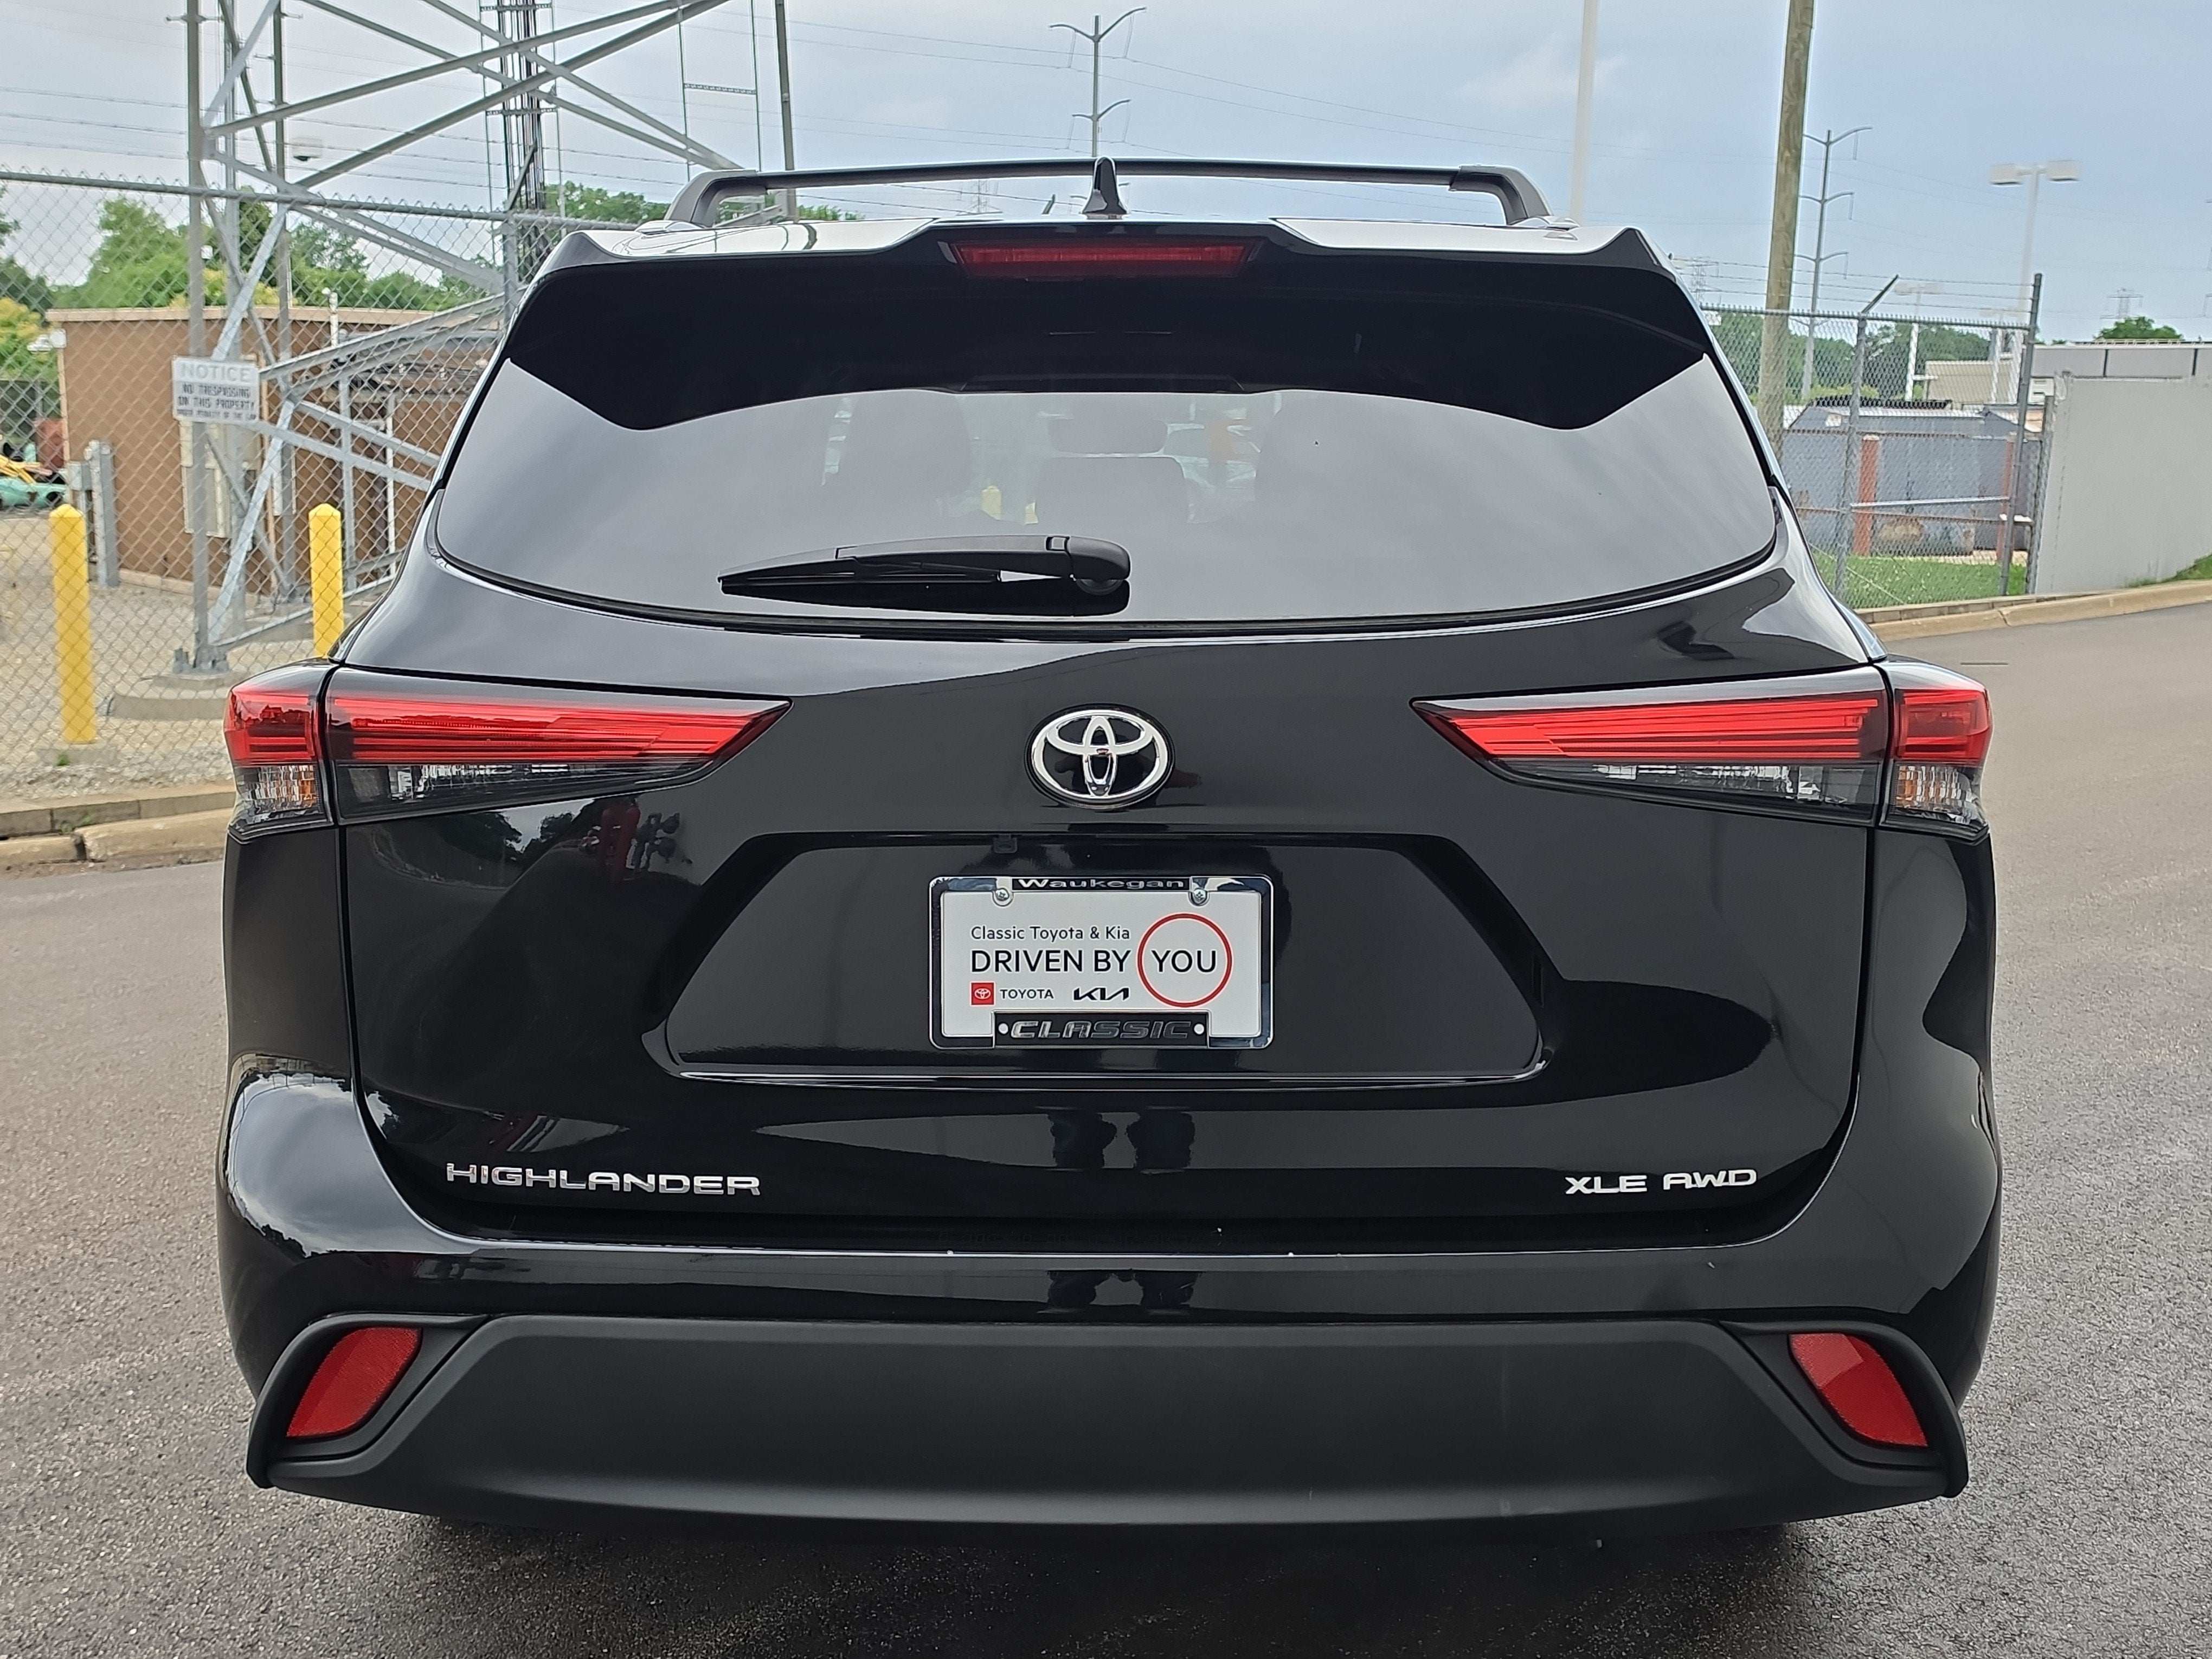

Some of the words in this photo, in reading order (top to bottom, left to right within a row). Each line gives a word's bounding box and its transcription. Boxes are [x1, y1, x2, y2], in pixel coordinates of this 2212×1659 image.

[181, 363, 250, 382] NOTICE
[182, 383, 194, 395] NO
[198, 385, 250, 398] TRESPASSING
[178, 396, 189, 406] ON
[193, 397, 211, 408] THIS
[215, 399, 255, 411] PROPERTY
[1018, 879, 1184, 890] Waukegan
[971, 926, 1025, 940] Classic
[1029, 926, 1084, 943] Toyota
[1090, 927, 1100, 940] &
[1106, 926, 1130, 940] Kia
[972, 950, 1083, 973] DRIVEN
[1094, 950, 1131, 973] BY
[1152, 949, 1217, 973] YOU
[1000, 989, 1054, 999] TOYOTA
[1011, 1021, 1192, 1039] CLASSIC
[446, 1162, 761, 1195] HIGHLANDER
[1565, 1175, 1648, 1194] XLE
[1663, 1169, 1757, 1191] AWD
